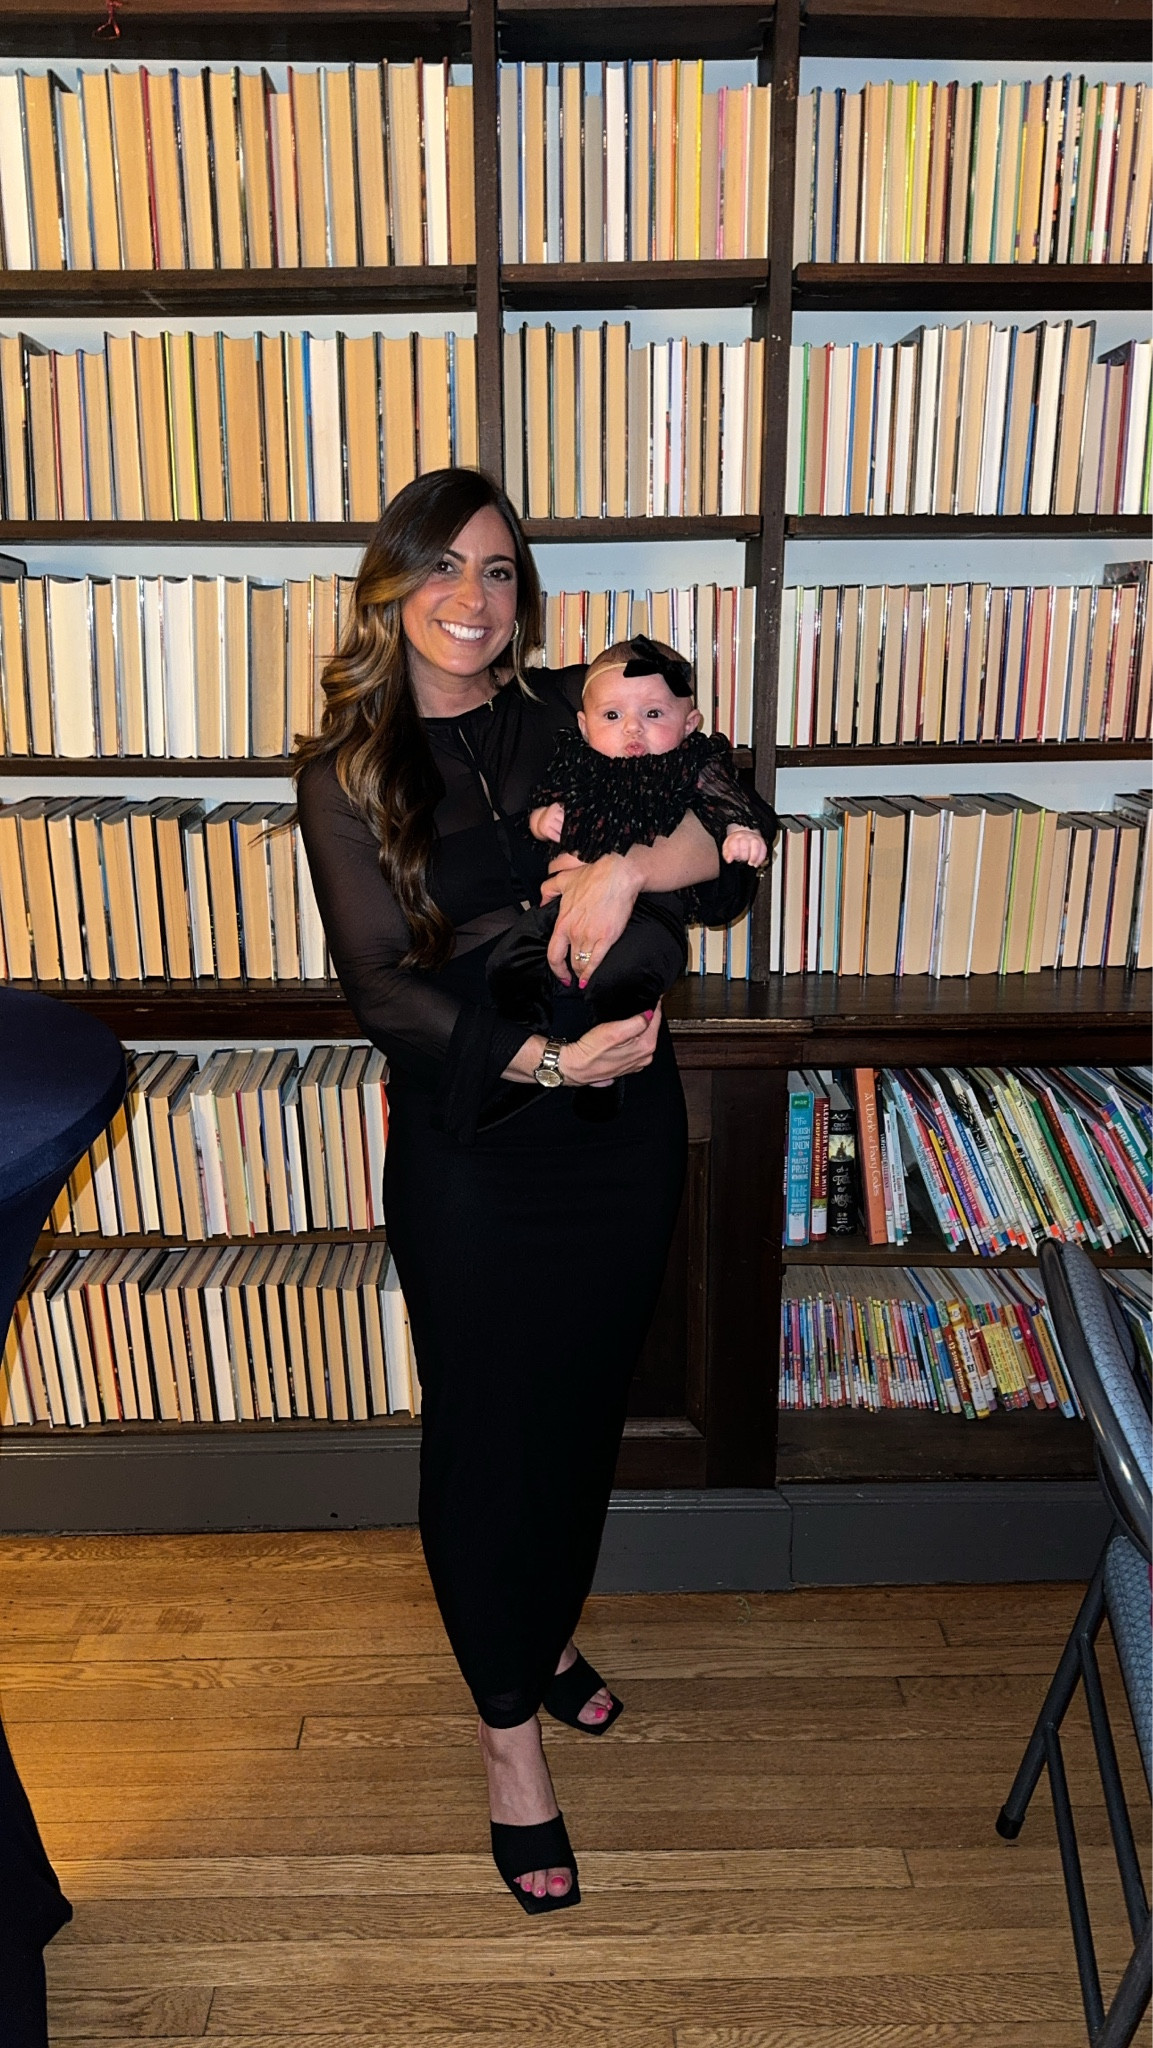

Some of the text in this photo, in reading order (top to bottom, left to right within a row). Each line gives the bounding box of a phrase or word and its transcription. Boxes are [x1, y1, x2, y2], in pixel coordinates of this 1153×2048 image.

[864, 1092, 874, 1101] A
[936, 1091, 951, 1119] JAN BRETT
[794, 1118, 807, 1126] The
[865, 1103, 877, 1133] World
[939, 1116, 956, 1155] GAIL GIBBONS
[956, 1123, 964, 1133] THE
[792, 1141, 810, 1150] UNION
[870, 1136, 876, 1144] of
[868, 1145, 880, 1169] Fairy
[1114, 1122, 1130, 1145] SANTA'S
[1126, 1144, 1140, 1162] NOISY
[1135, 1160, 1149, 1179] NIGHT
[792, 1165, 809, 1174] PRIZE
[962, 1155, 975, 1177] EASTER
[971, 1177, 980, 1189] EGG
[954, 1157, 970, 1192] VALENTINE'S
[967, 1192, 976, 1204] DAY
[791, 1185, 807, 1197] THE
